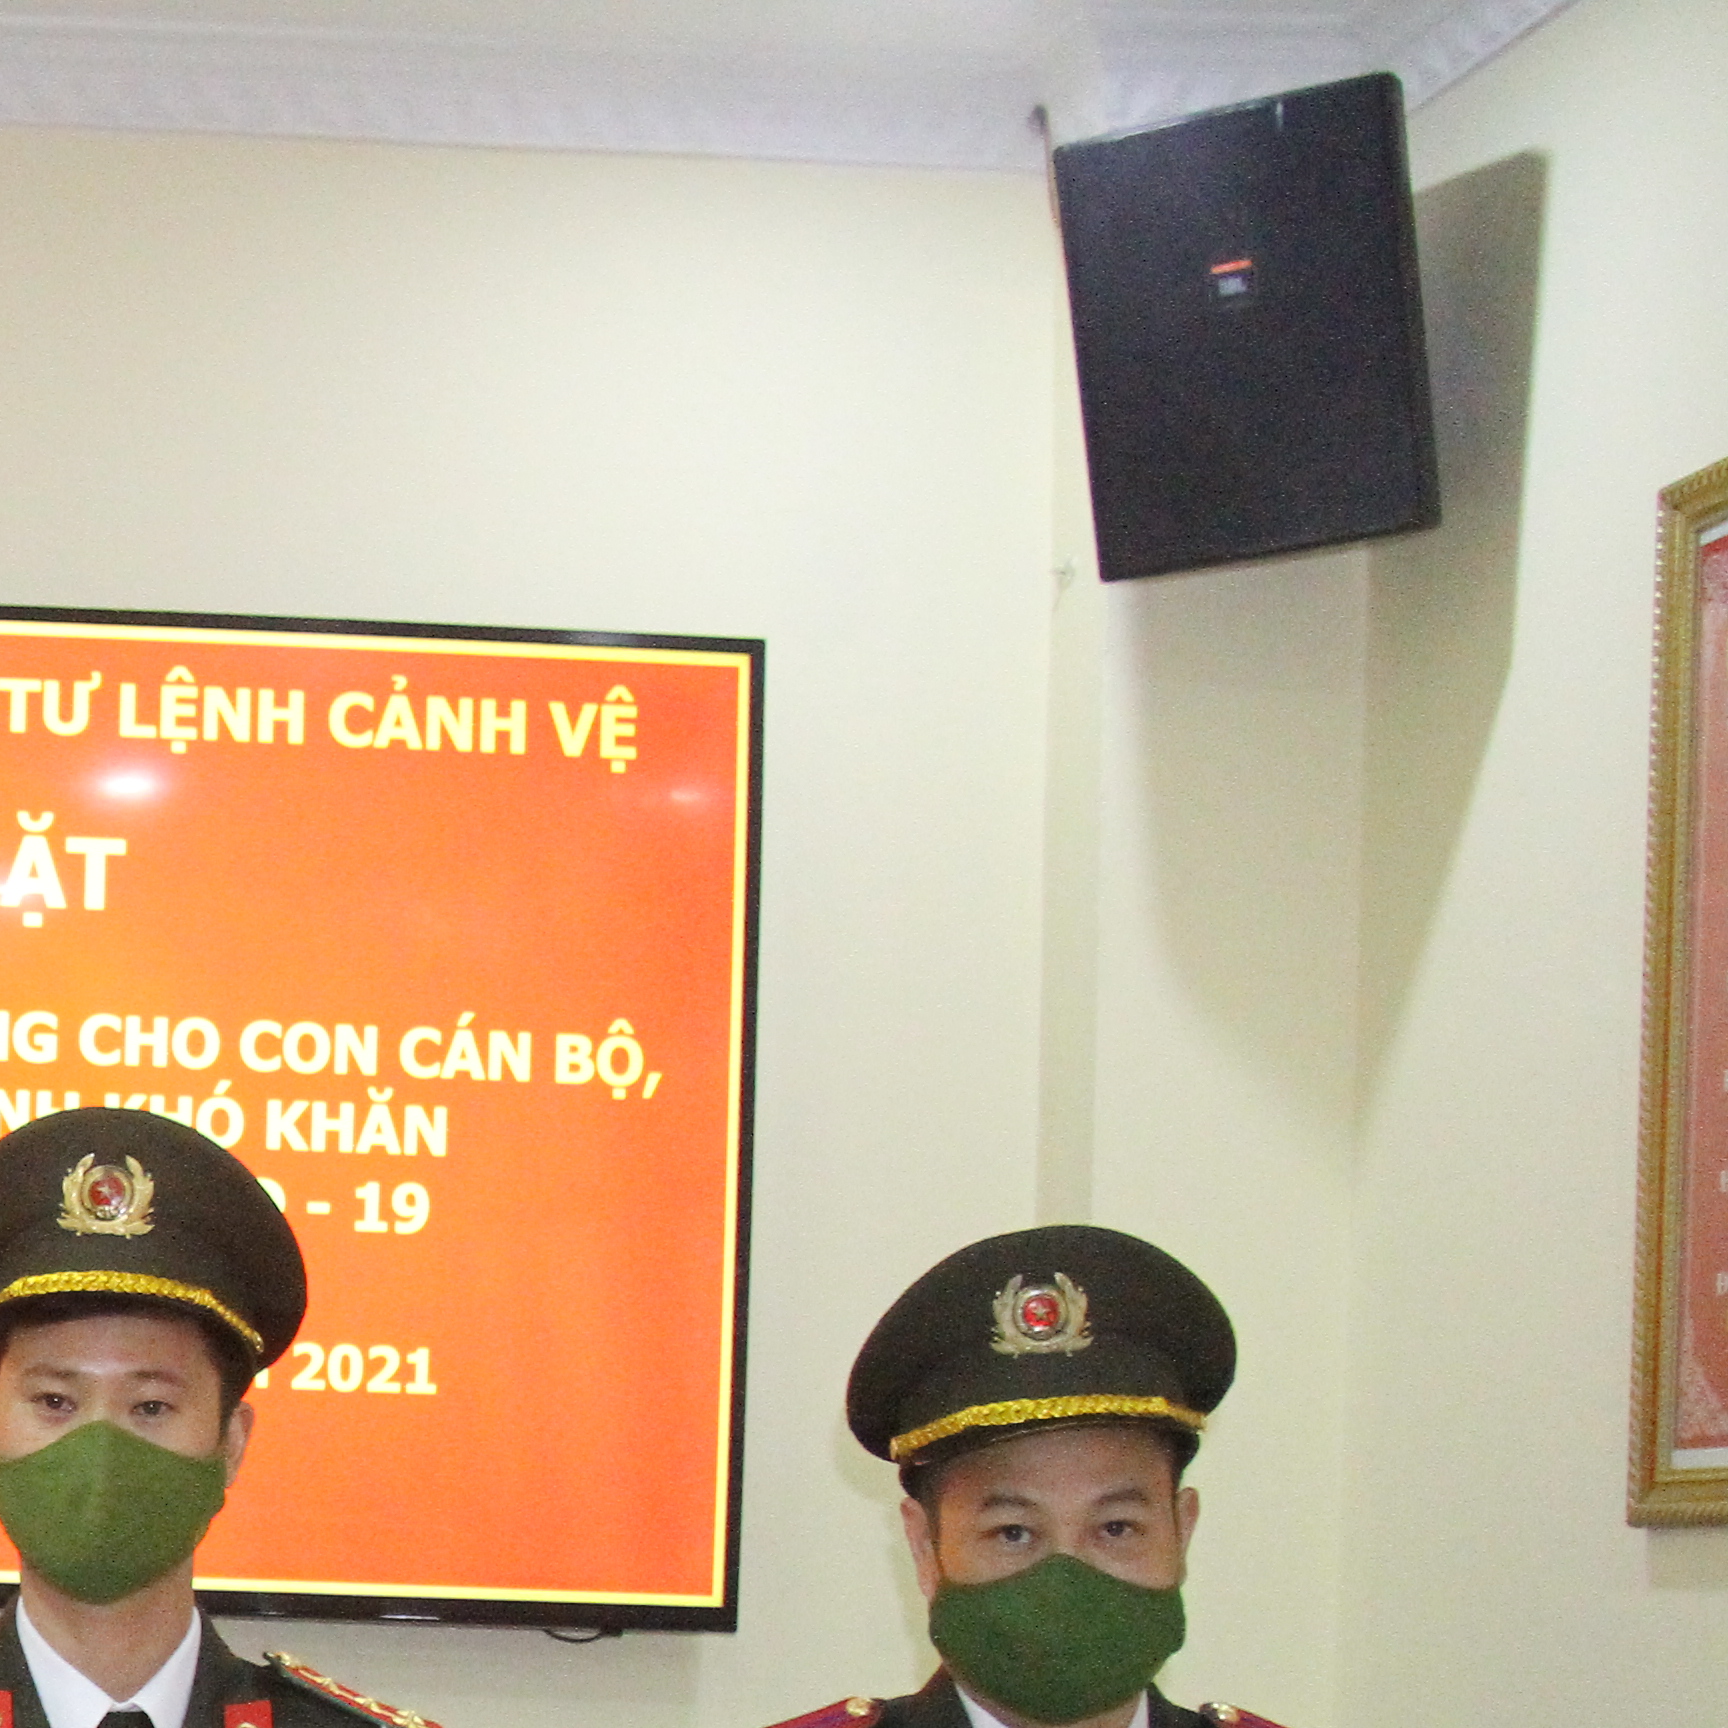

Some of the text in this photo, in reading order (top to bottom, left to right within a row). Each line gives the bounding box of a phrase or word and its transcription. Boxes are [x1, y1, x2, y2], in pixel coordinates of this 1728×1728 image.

[119, 666, 306, 755] LỆNH
[328, 675, 527, 755] CẢNH
[549, 686, 640, 774] VỆ
[78, 1012, 221, 1071] CHO
[238, 1018, 378, 1077] CON
[399, 1012, 533, 1083] CÁN
[555, 1019, 664, 1101] BỘ,
[264, 1087, 450, 1158] KHĂN
[353, 1180, 431, 1235] 19
[290, 1341, 438, 1395] 2021
